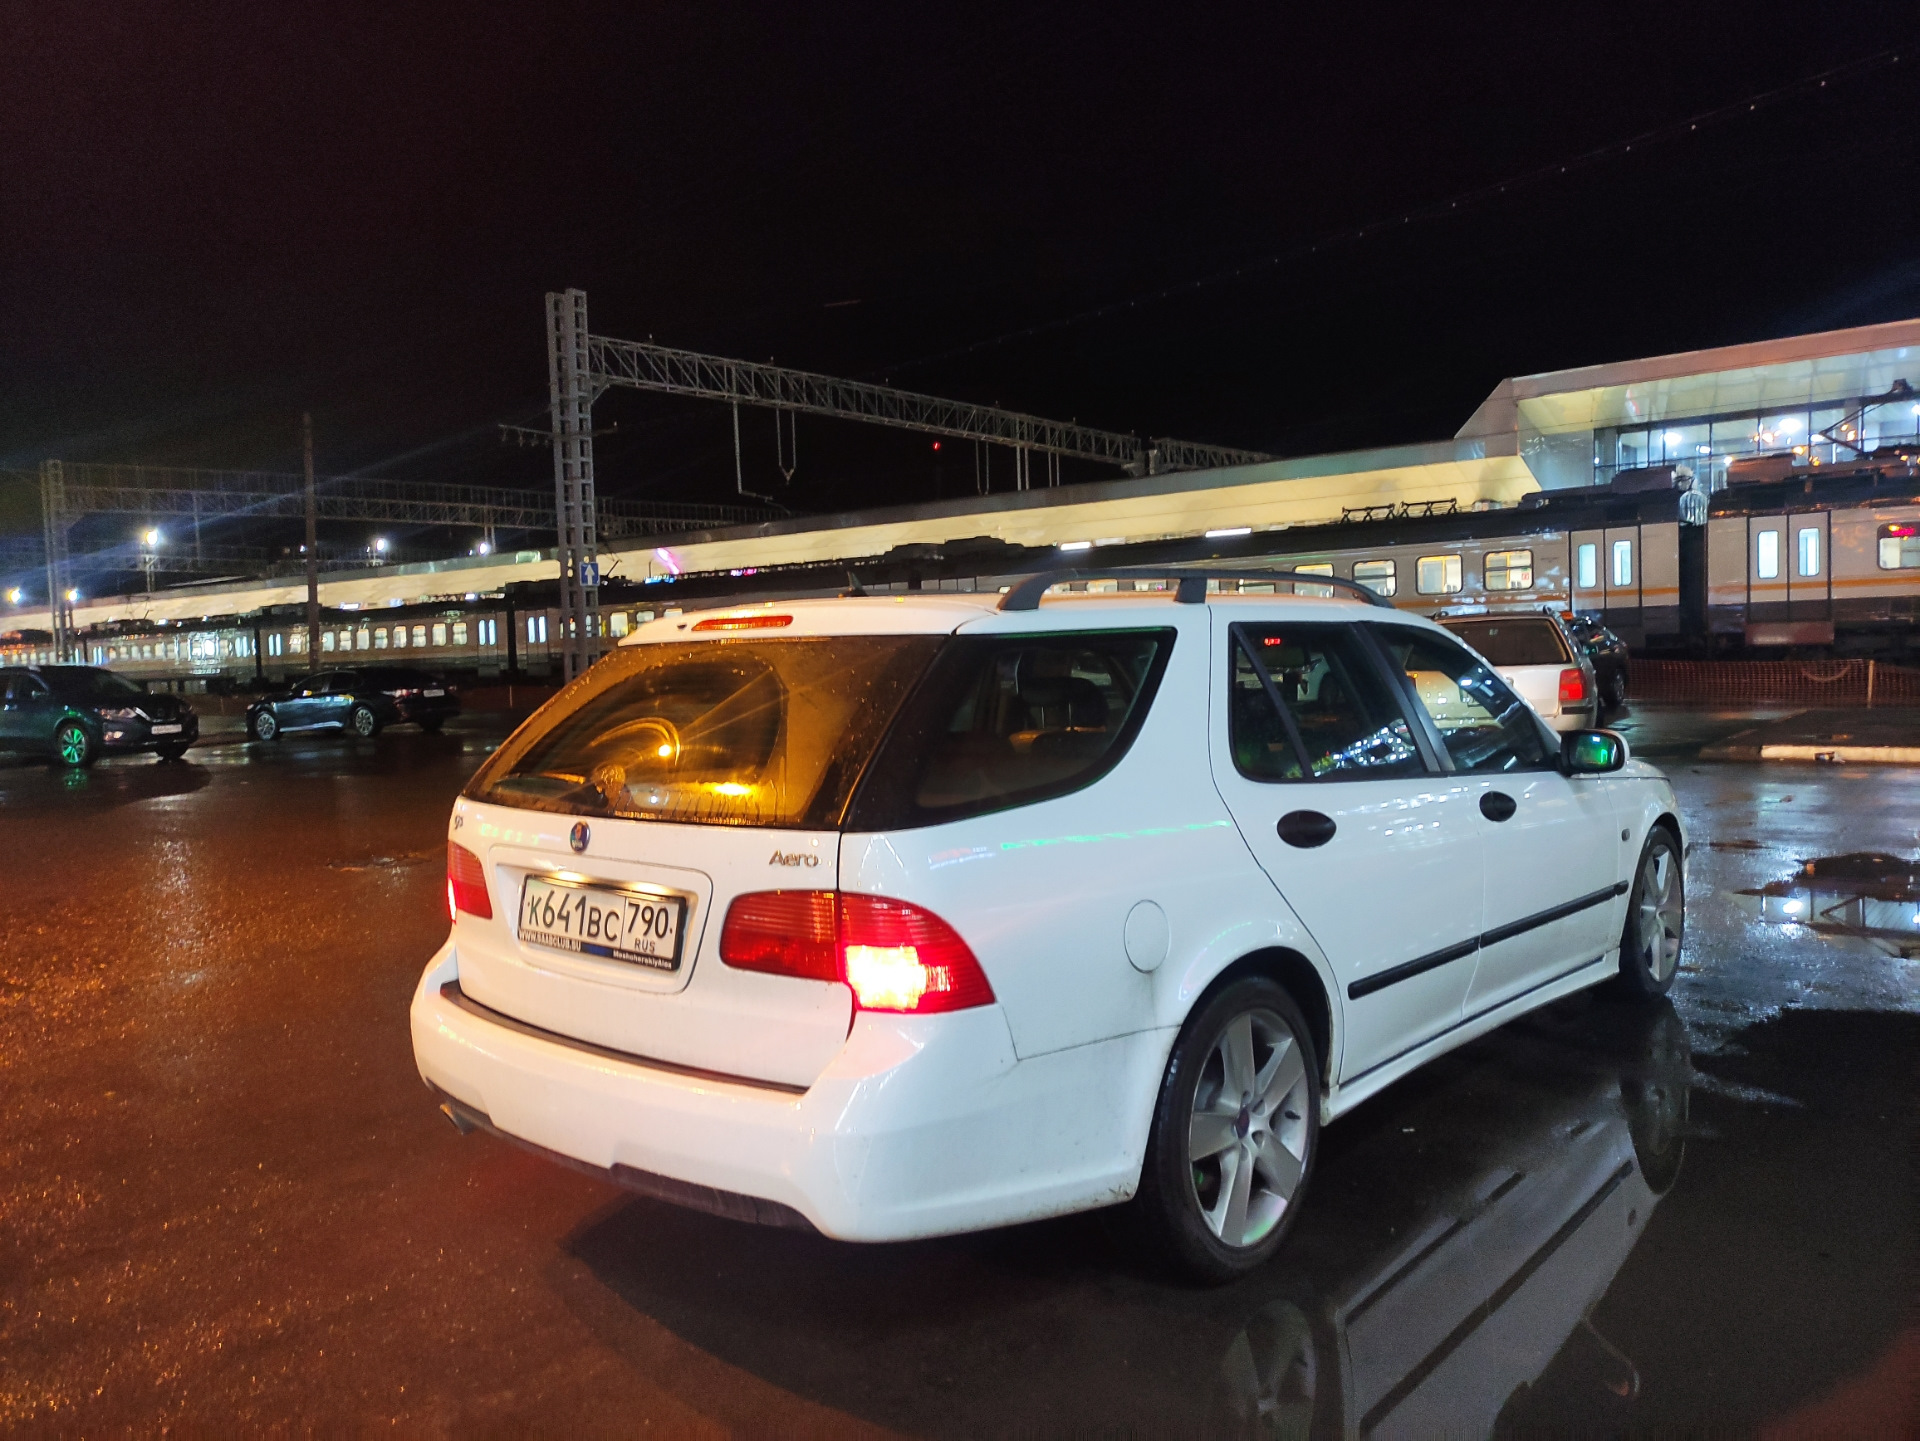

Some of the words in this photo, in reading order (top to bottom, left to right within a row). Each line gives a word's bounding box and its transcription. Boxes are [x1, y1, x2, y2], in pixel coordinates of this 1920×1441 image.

[768, 849, 819, 868] Aero
[627, 902, 669, 939] 790
[634, 937, 656, 955] RUS
